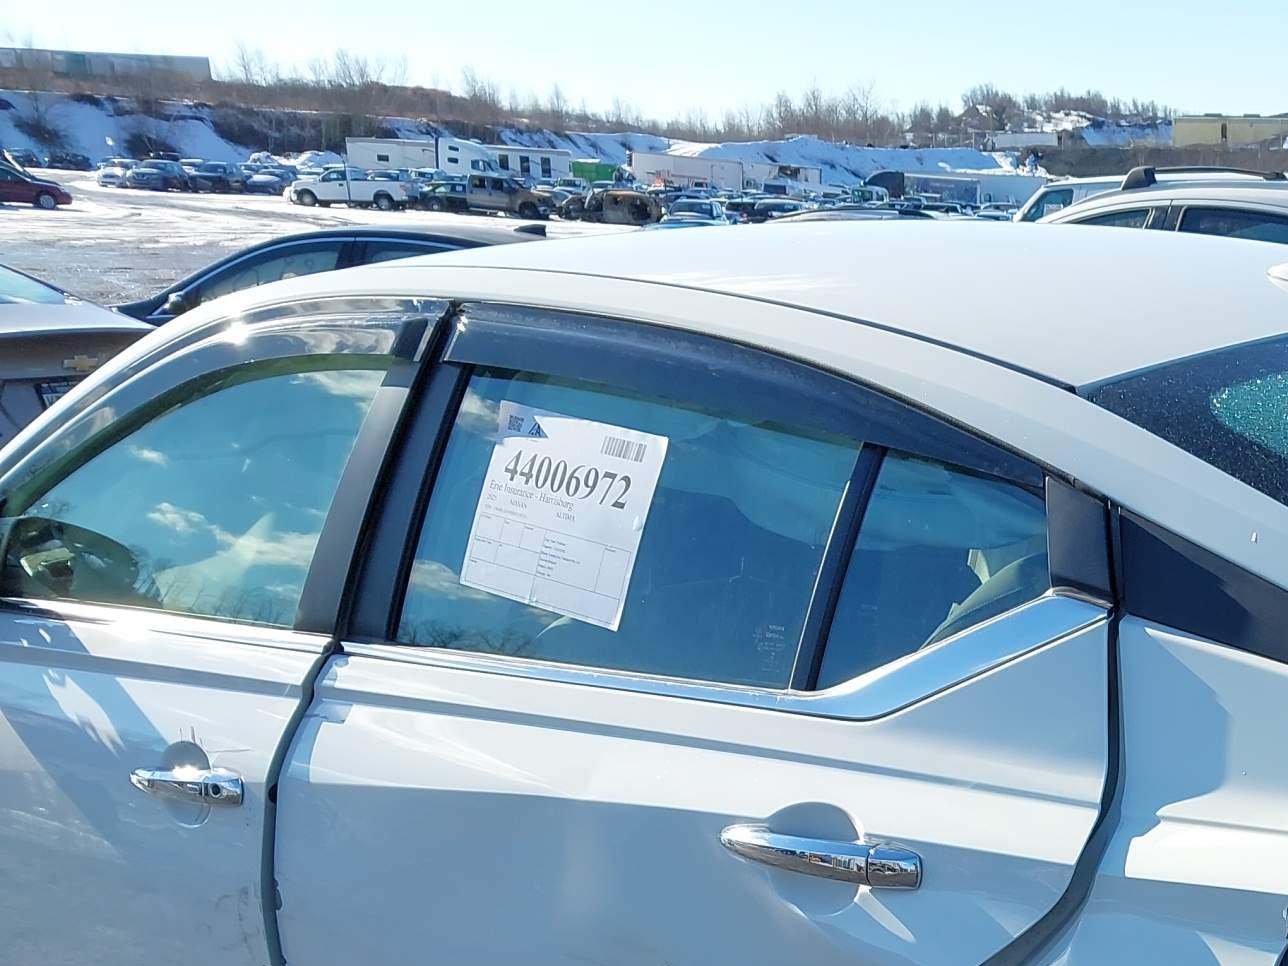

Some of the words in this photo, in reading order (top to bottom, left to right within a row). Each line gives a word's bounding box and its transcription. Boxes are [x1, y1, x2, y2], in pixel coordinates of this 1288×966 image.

[489, 479, 504, 491] Erie
[504, 483, 534, 499] Insurance
[539, 492, 574, 511] Harrisburg
[504, 449, 632, 510] 44006972
